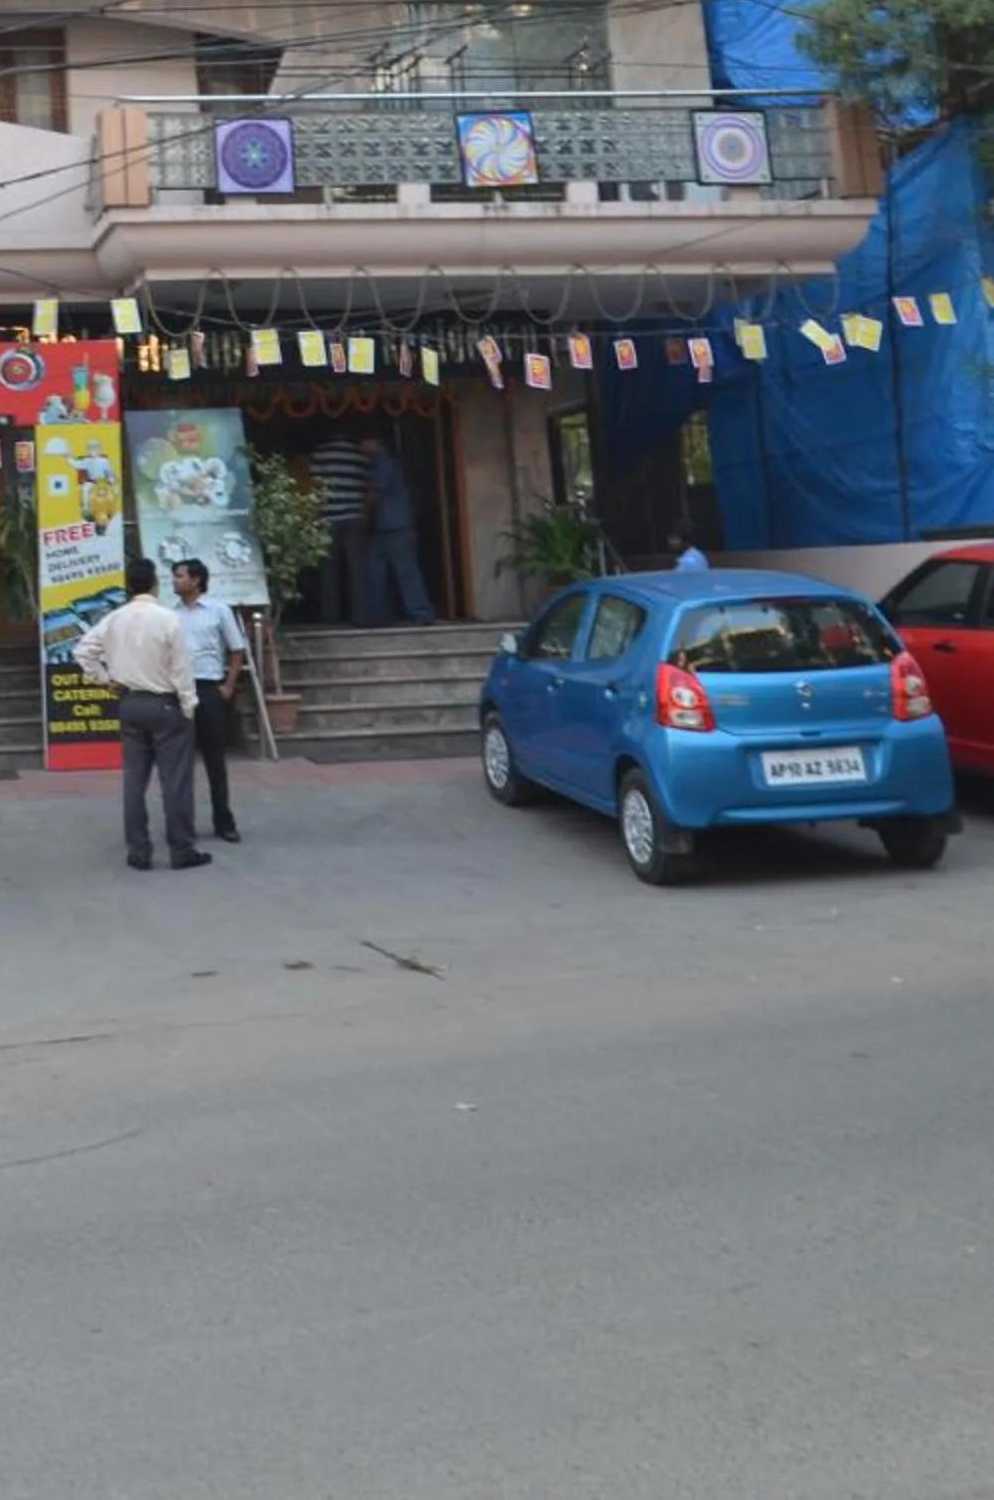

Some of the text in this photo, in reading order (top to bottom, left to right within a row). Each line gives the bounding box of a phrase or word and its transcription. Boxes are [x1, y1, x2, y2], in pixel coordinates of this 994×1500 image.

[43, 522, 95, 546] FREE
[46, 546, 79, 559] HOME
[48, 554, 101, 573] DELIVERY
[52, 673, 80, 687] OUT
